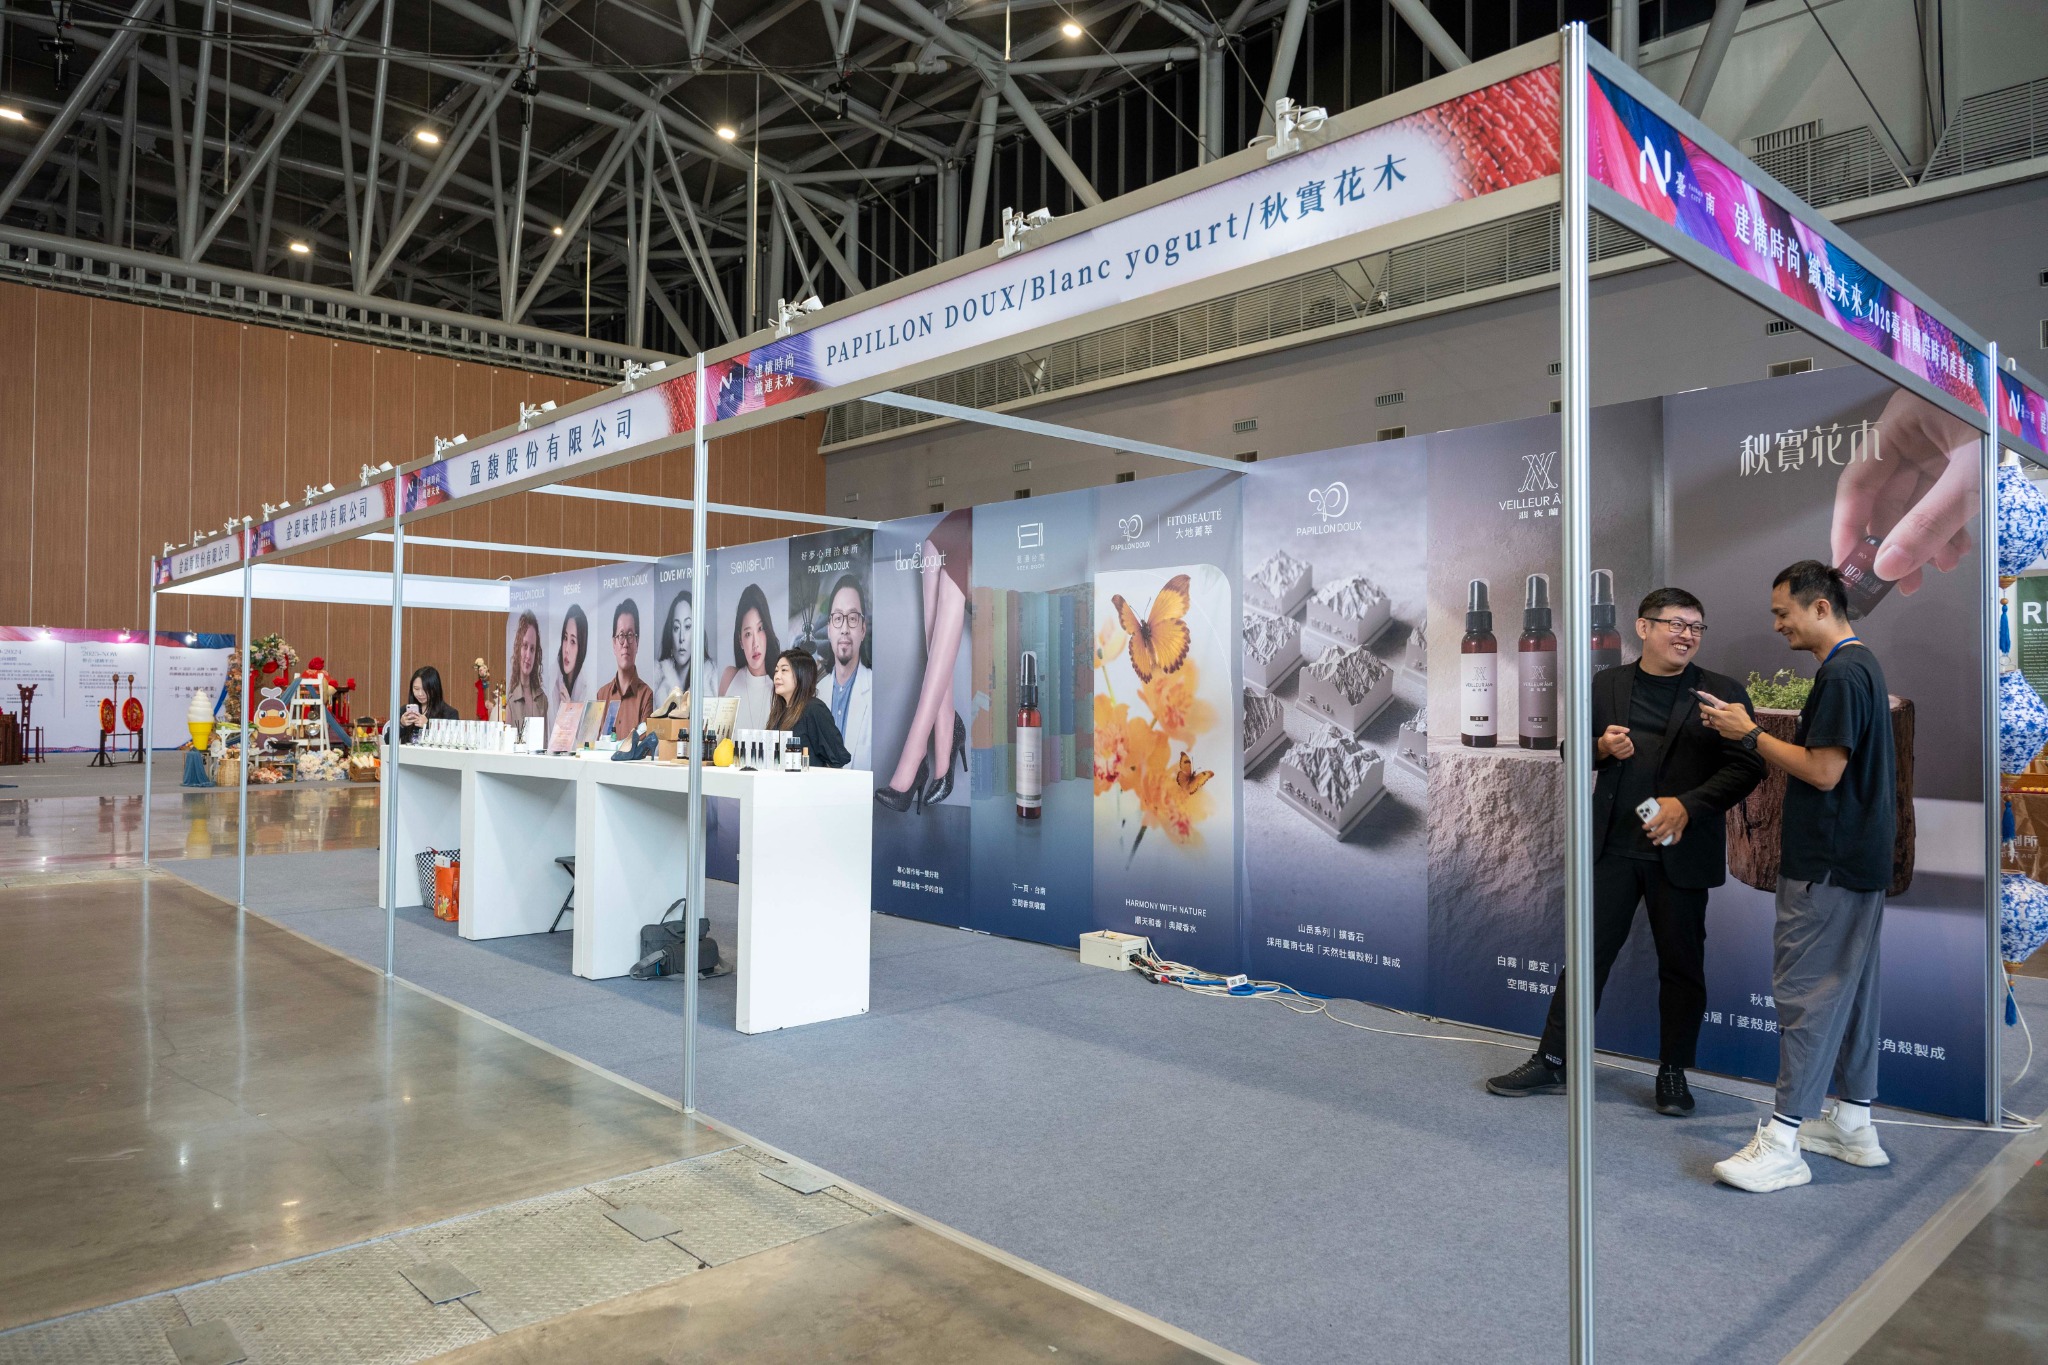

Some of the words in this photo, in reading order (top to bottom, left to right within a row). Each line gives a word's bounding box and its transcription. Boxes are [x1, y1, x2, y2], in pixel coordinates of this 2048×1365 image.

[827, 313, 932, 366] PAPILLON
[945, 257, 1110, 329] DOUX/Blanc
[1125, 154, 1407, 279] yogurt/秋實花木
[1734, 202, 1800, 279] 建構時尚
[1808, 251, 1862, 317] 織連未來
[469, 408, 632, 486] 盈馥股份有限公司
[1739, 419, 1884, 478] 秋實花木
[1498, 496, 1550, 511] VEILLEUR
[1167, 508, 1222, 527] FITOBEAUTÉ
[1296, 523, 1336, 536] PAPILLON
[1337, 520, 1362, 532] DOUX
[1110, 542, 1136, 552] PAPILLON
[1136, 540, 1150, 549] DOUX
[660, 570, 676, 582] LOVE
[676, 569, 686, 580] MY
[808, 563, 832, 574] PAPILLON
[834, 560, 850, 572] DOUX
[604, 576, 631, 589] PAPILLON
[632, 574, 648, 586] DOUX
[2022, 601, 2048, 625] R
[1126, 898, 1158, 910] HARMONY
[1160, 903, 1178, 913] WITH
[1180, 906, 1206, 918] NATURE
[1878, 1037, 1946, 1060] 角殼製成
